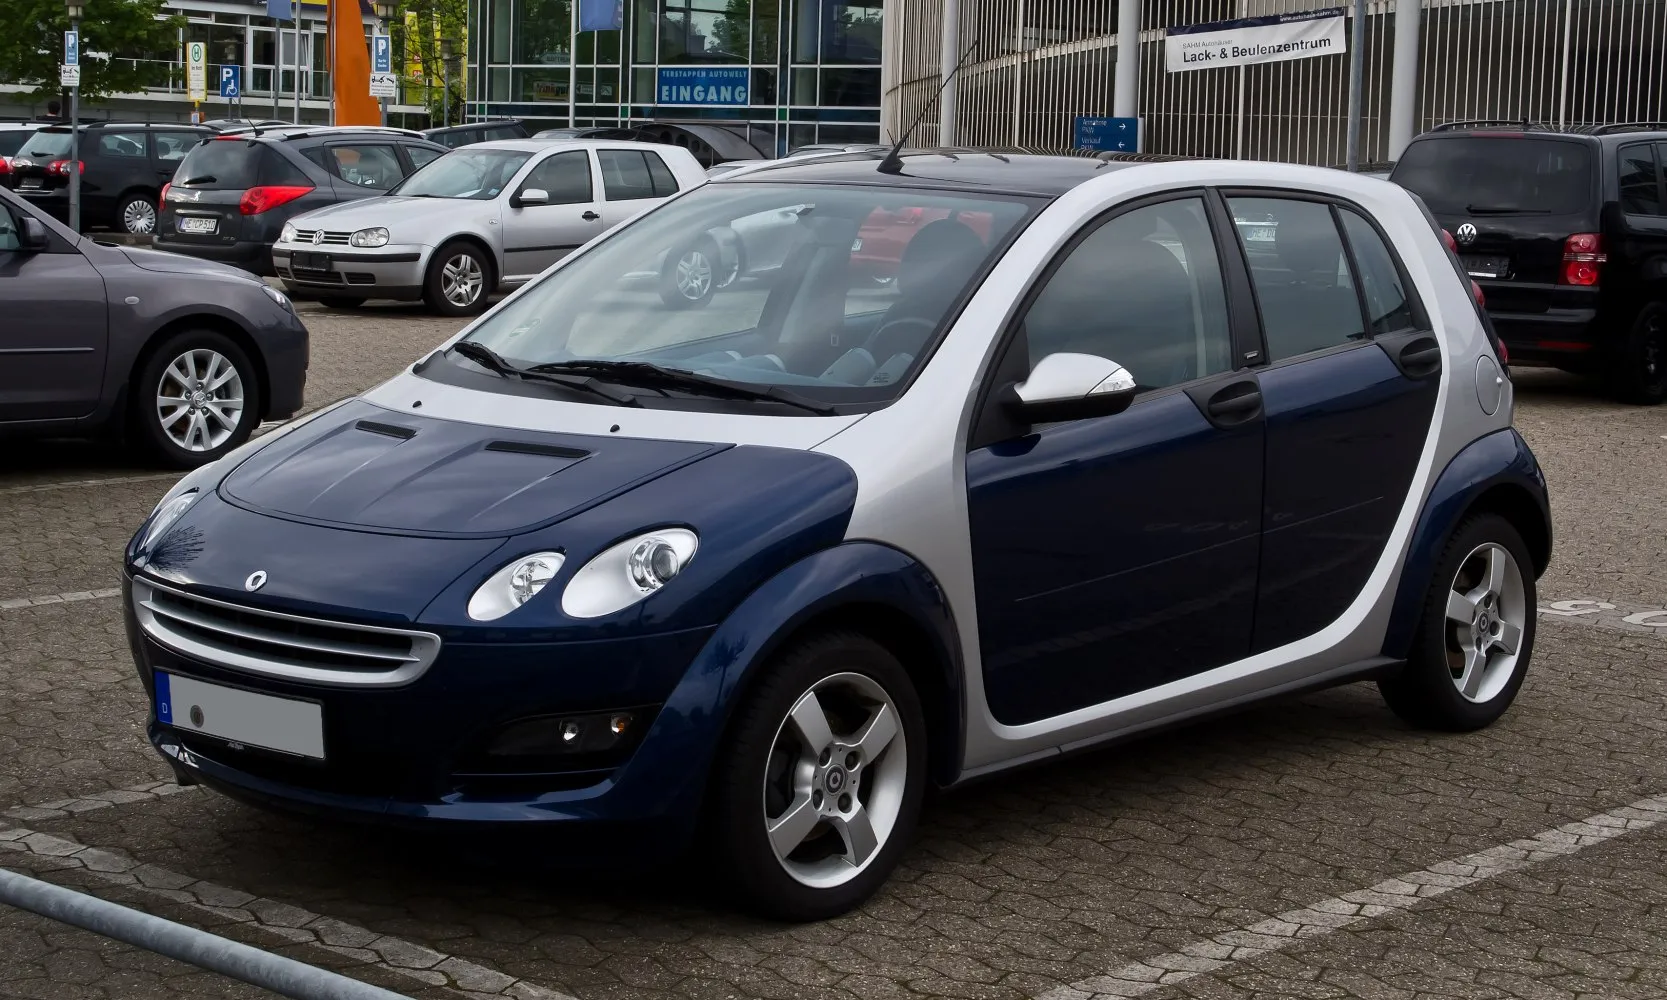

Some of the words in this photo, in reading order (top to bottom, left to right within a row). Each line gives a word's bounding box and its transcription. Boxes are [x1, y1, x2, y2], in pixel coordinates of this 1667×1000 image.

[68, 34, 75, 48] P
[378, 39, 387, 56] P
[1183, 49, 1216, 63] Lack-
[1219, 47, 1229, 60] &
[1232, 37, 1331, 58] Beulenzentrum
[222, 68, 234, 82] P
[709, 70, 747, 78] AUTOWELT
[661, 85, 747, 103] EINGANG
